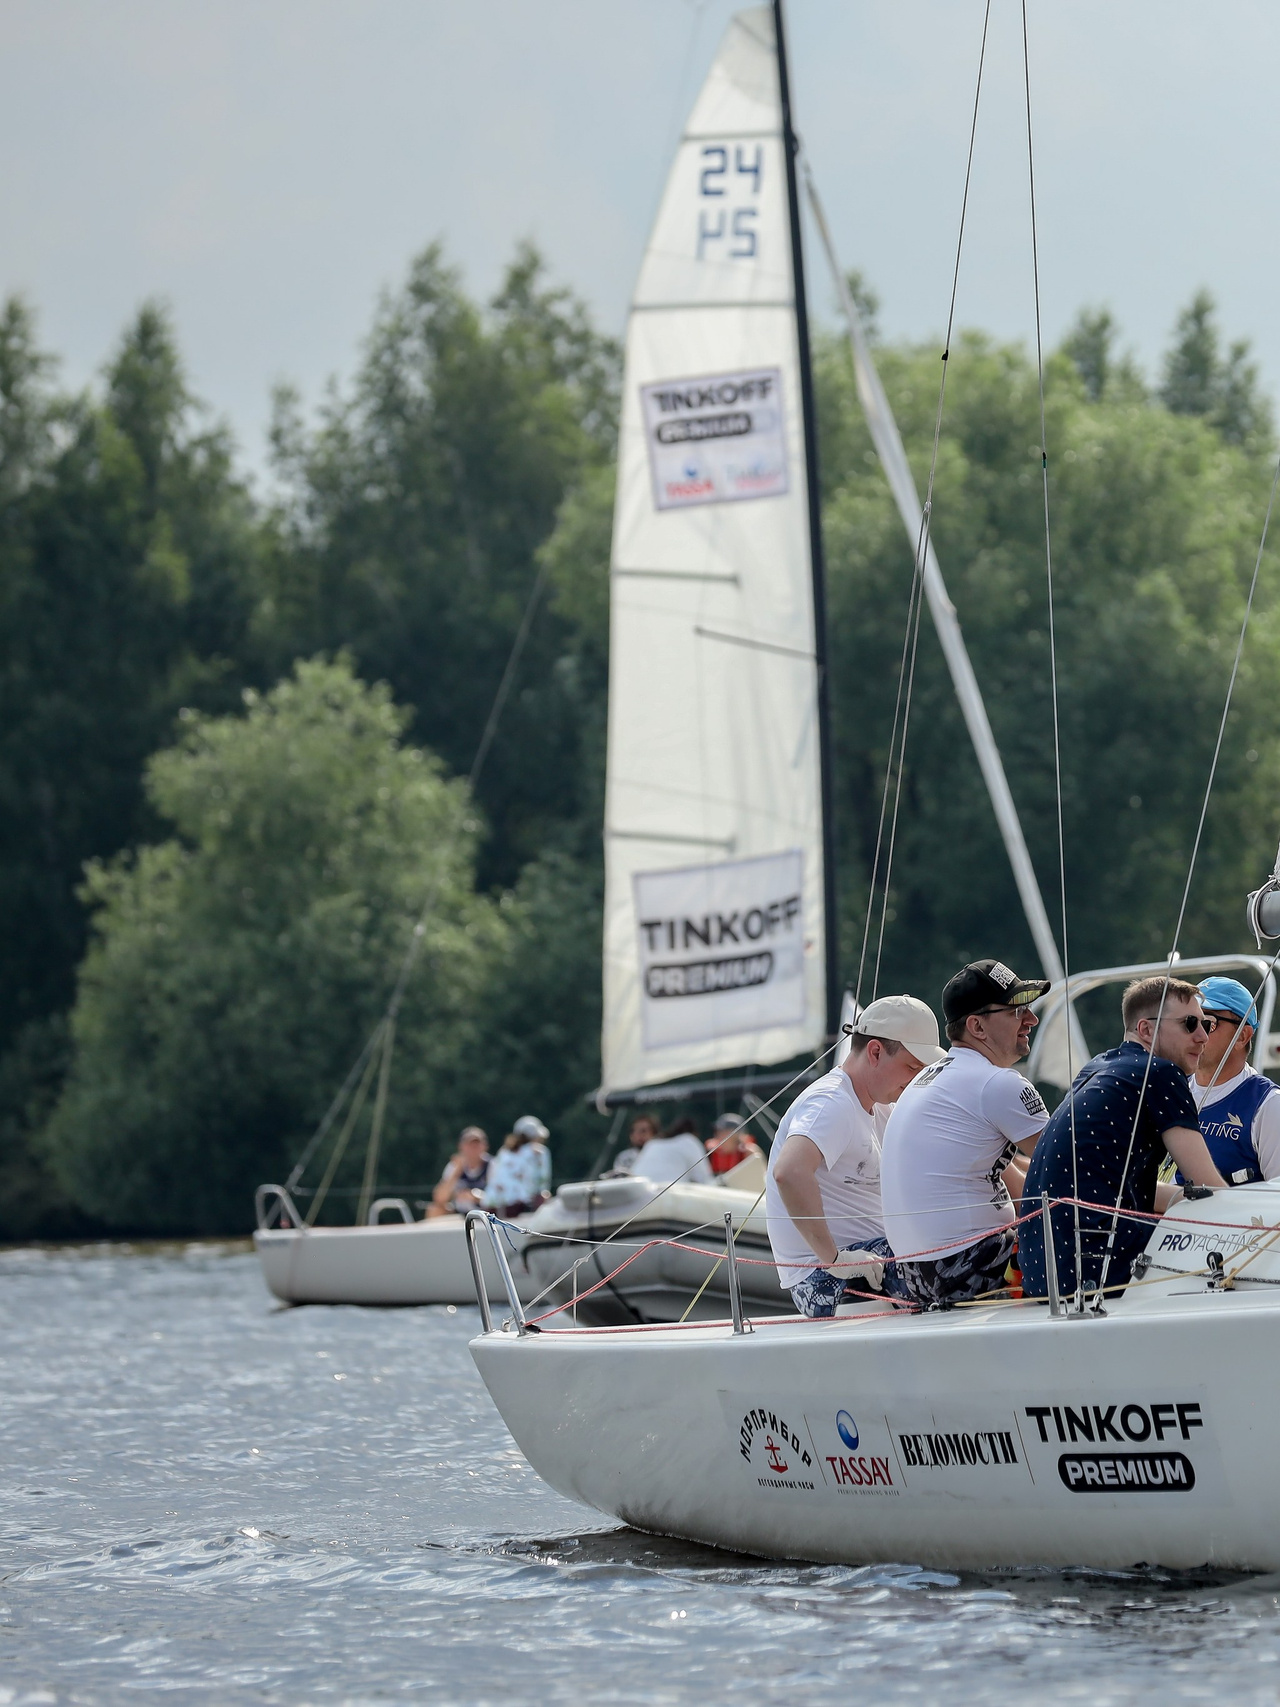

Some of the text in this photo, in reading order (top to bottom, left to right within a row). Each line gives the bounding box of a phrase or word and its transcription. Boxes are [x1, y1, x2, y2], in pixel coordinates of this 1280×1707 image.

[700, 145, 762, 197] 24
[640, 894, 800, 951] TINKOFF
[649, 953, 768, 996] PREMIUM
[1199, 1120, 1241, 1141] HTING
[739, 1408, 812, 1464] МОРПРИБОР
[1025, 1403, 1204, 1443] TINKOFF
[898, 1431, 1019, 1470] ВЕДОМОСТИ
[826, 1456, 894, 1487] TASSAY
[1064, 1459, 1188, 1486] PREMIUM
